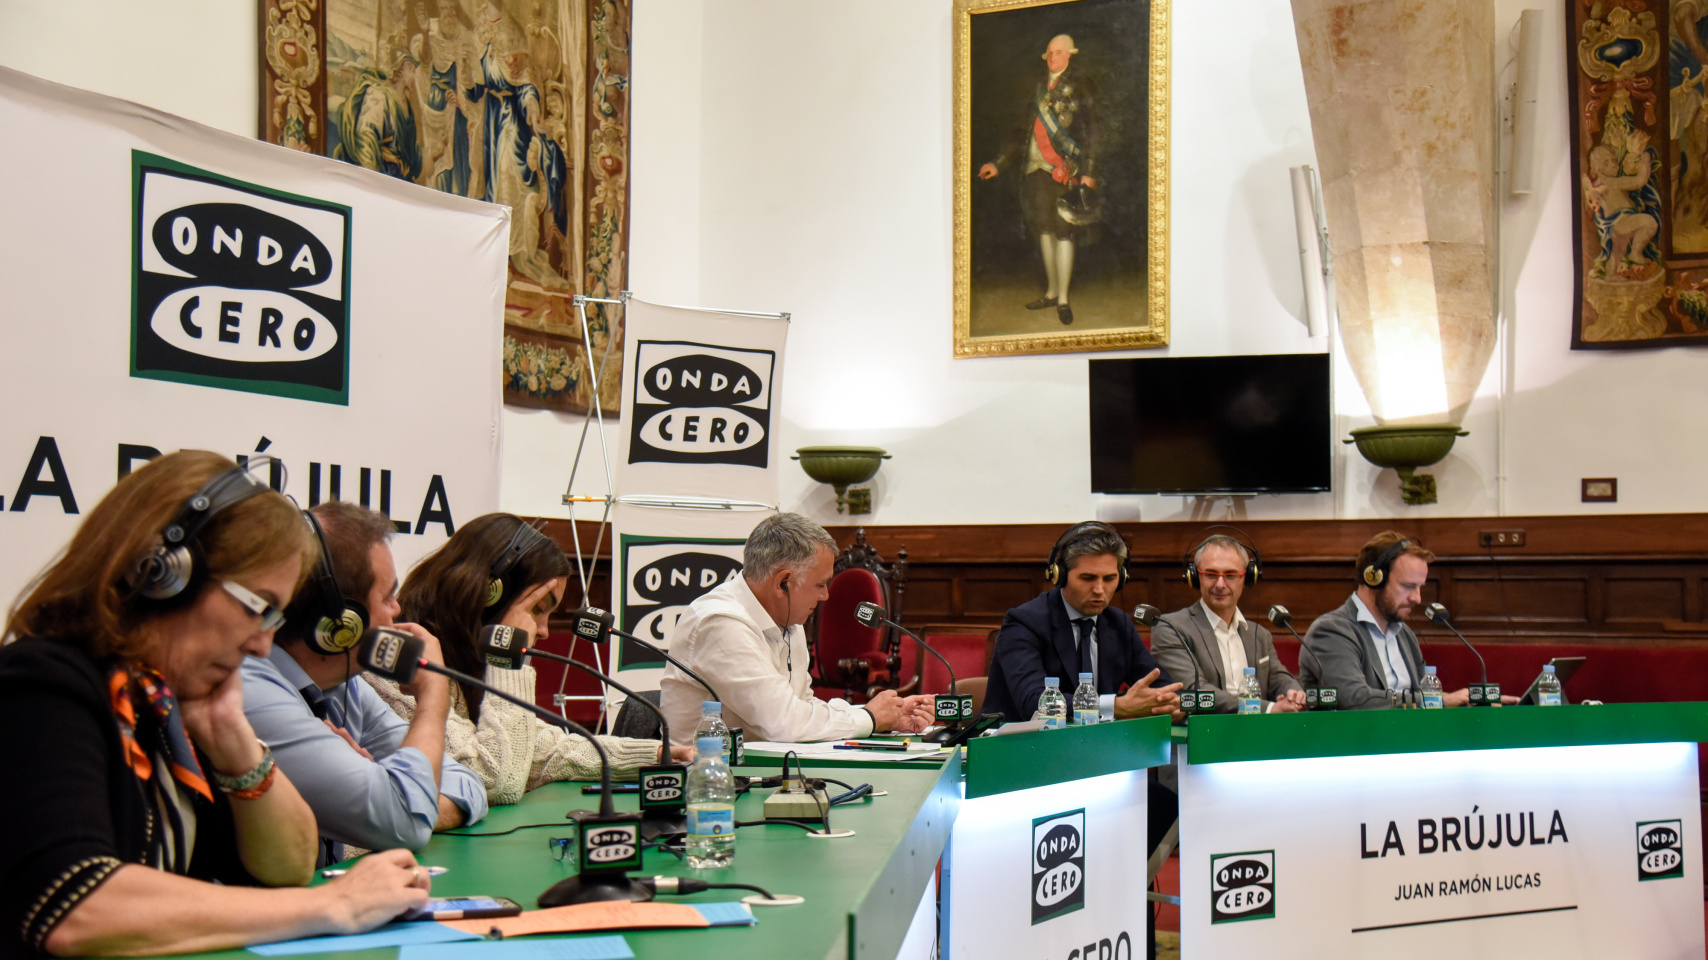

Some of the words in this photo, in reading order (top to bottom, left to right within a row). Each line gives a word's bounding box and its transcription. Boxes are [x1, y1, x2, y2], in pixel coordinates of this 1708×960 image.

[171, 216, 316, 275] ONDA
[180, 295, 315, 351] CERO
[655, 367, 751, 395] ONDA
[658, 414, 750, 444] CERO
[0, 436, 80, 514] A
[649, 778, 678, 786] ONDA
[651, 789, 678, 798] CERO
[592, 832, 631, 844] ONDA
[1361, 821, 1405, 859] LA
[1418, 804, 1569, 854] BRÚJULA
[1644, 832, 1675, 847] ONDA
[595, 847, 630, 858] CERO
[1041, 833, 1077, 860] ONDA
[1647, 853, 1676, 868] CERO
[1042, 870, 1076, 899] CERO
[1221, 866, 1264, 883] ONDA
[1394, 883, 1434, 901] JUAN
[1439, 874, 1492, 897] RAMÓN
[1496, 872, 1541, 891] LUCAS
[1224, 891, 1265, 908] CERO
